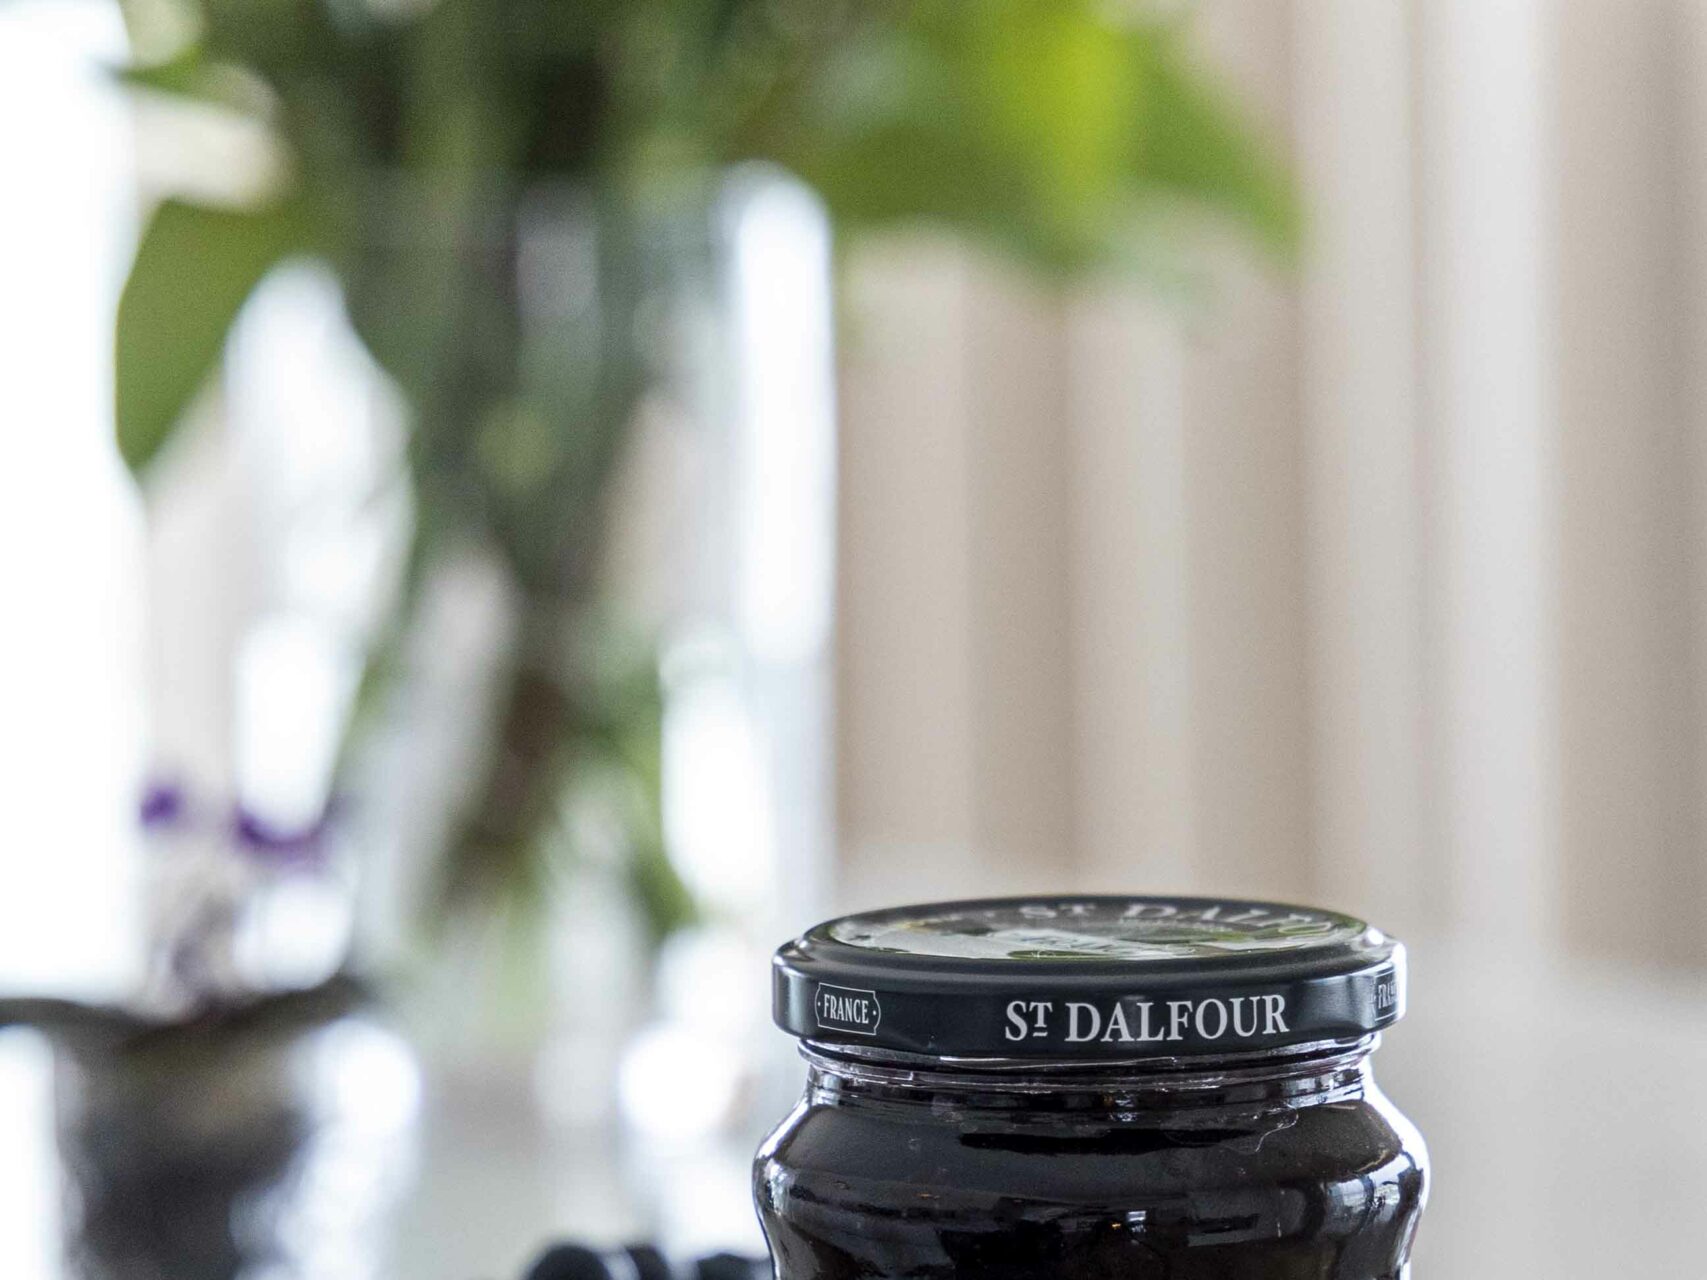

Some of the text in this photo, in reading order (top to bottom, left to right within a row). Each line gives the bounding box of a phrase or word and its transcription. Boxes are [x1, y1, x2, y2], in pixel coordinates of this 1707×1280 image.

[822, 993, 870, 1025] FRANCE
[1005, 994, 1291, 1042] ST DALFOUR
